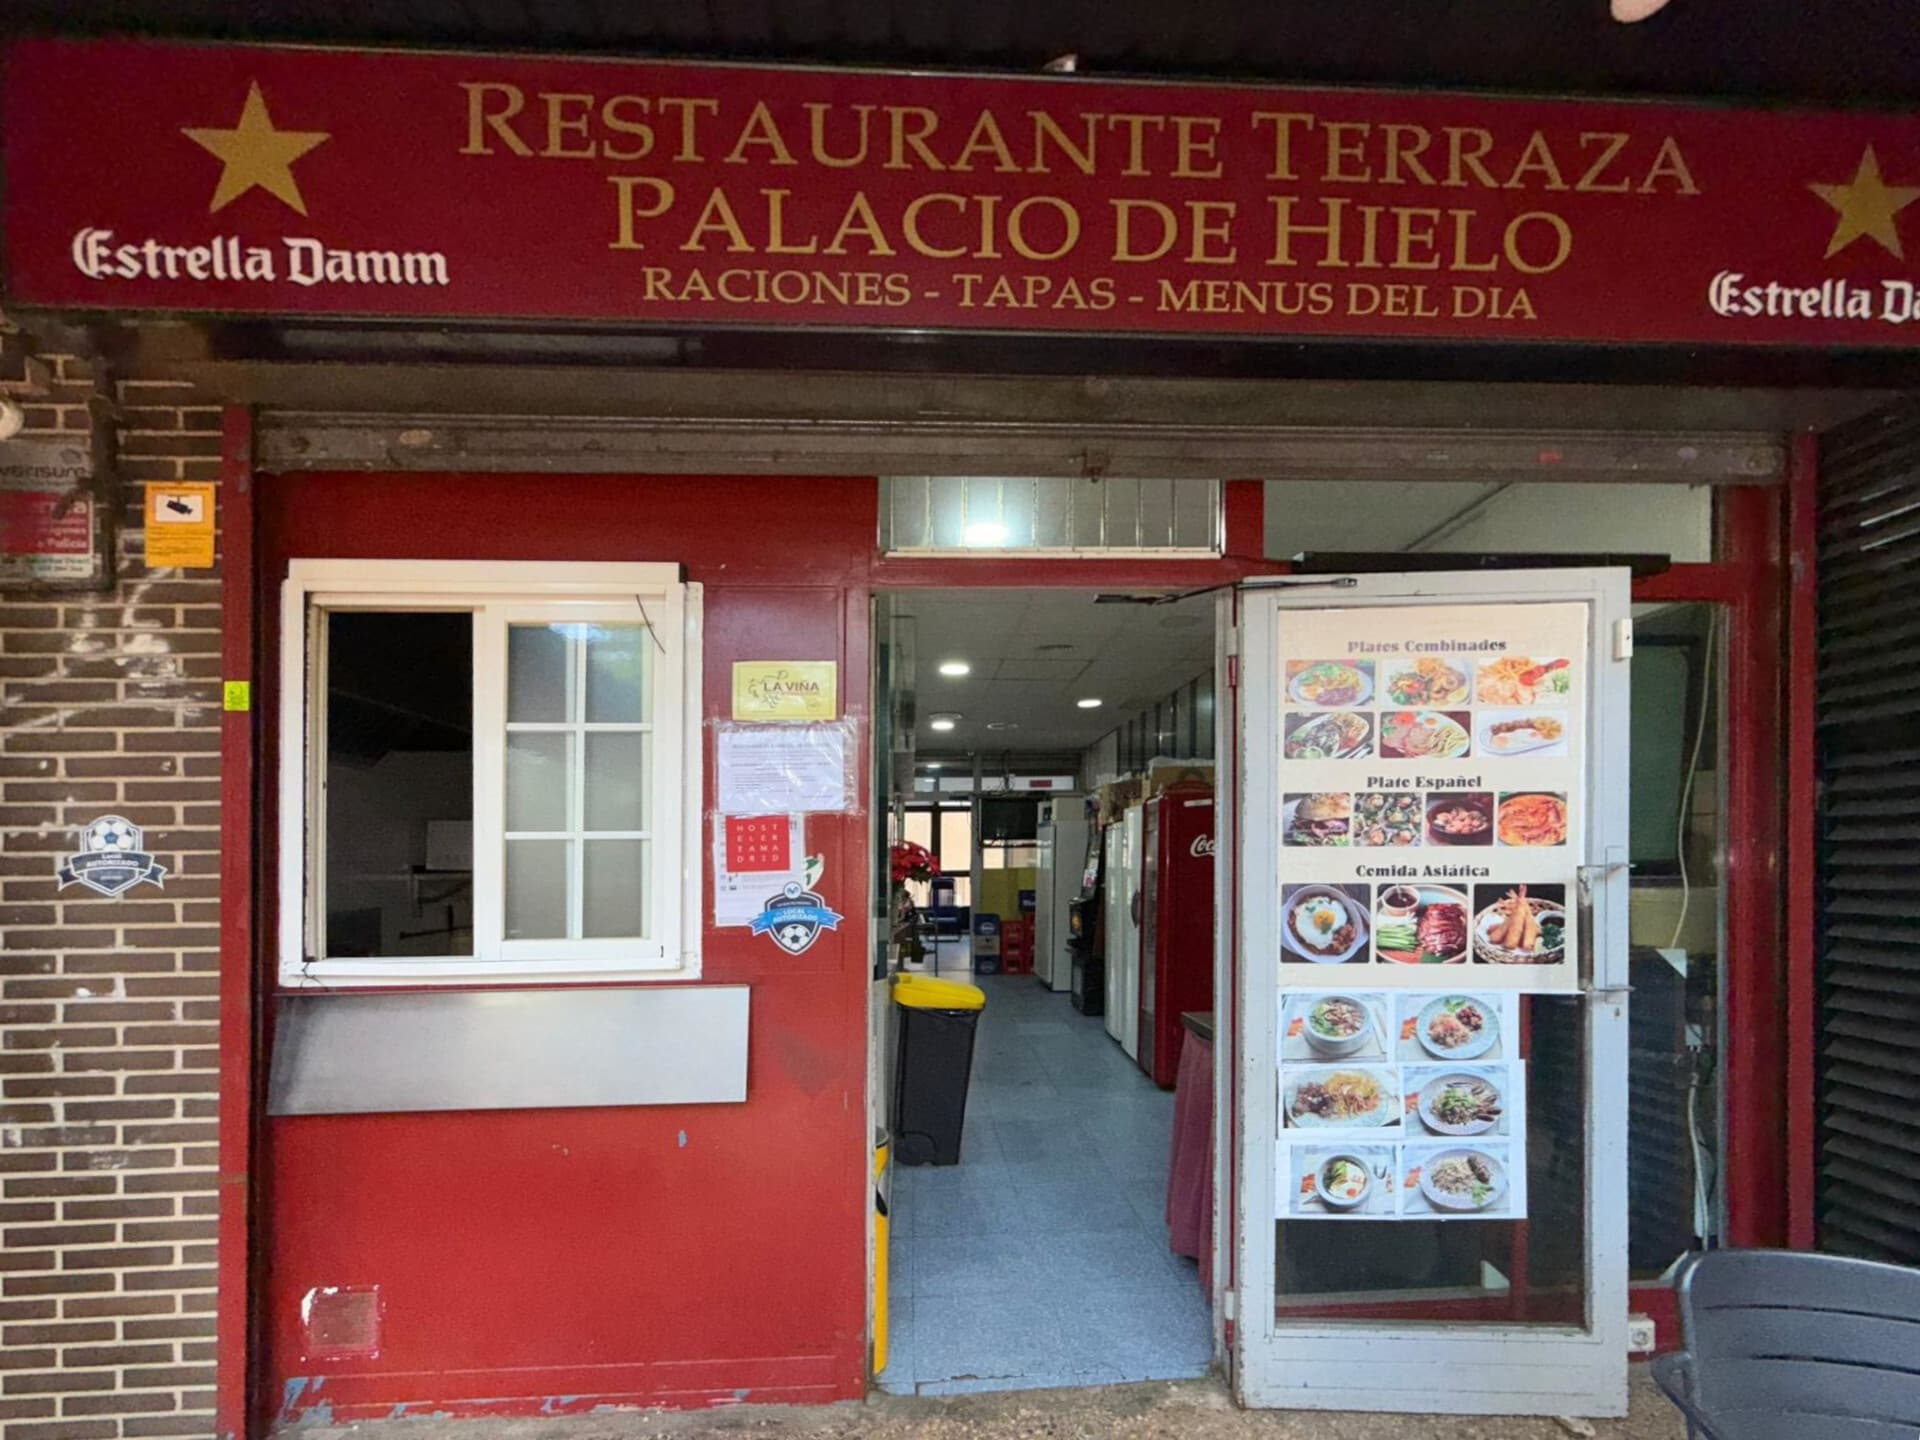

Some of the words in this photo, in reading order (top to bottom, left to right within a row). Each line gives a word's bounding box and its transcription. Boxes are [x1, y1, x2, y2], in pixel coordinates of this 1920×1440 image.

[459, 82, 1223, 179] RESTAURANTE
[1252, 112, 1700, 194] TERRAZA
[608, 176, 1081, 261] PALACIO
[1109, 198, 1237, 264] DE
[1265, 196, 1573, 274] HIELO
[72, 227, 275, 280] Estrella
[282, 237, 450, 286] Damm
[641, 266, 911, 307] RACIONES
[953, 273, 1116, 310] TAPAS
[1157, 279, 1333, 315] MENUS
[1346, 283, 1439, 317] DEL
[1451, 286, 1537, 319] DIA
[1708, 269, 1873, 319] Estrella
[763, 681, 782, 692] LA
[1190, 833, 1215, 858] Coc
